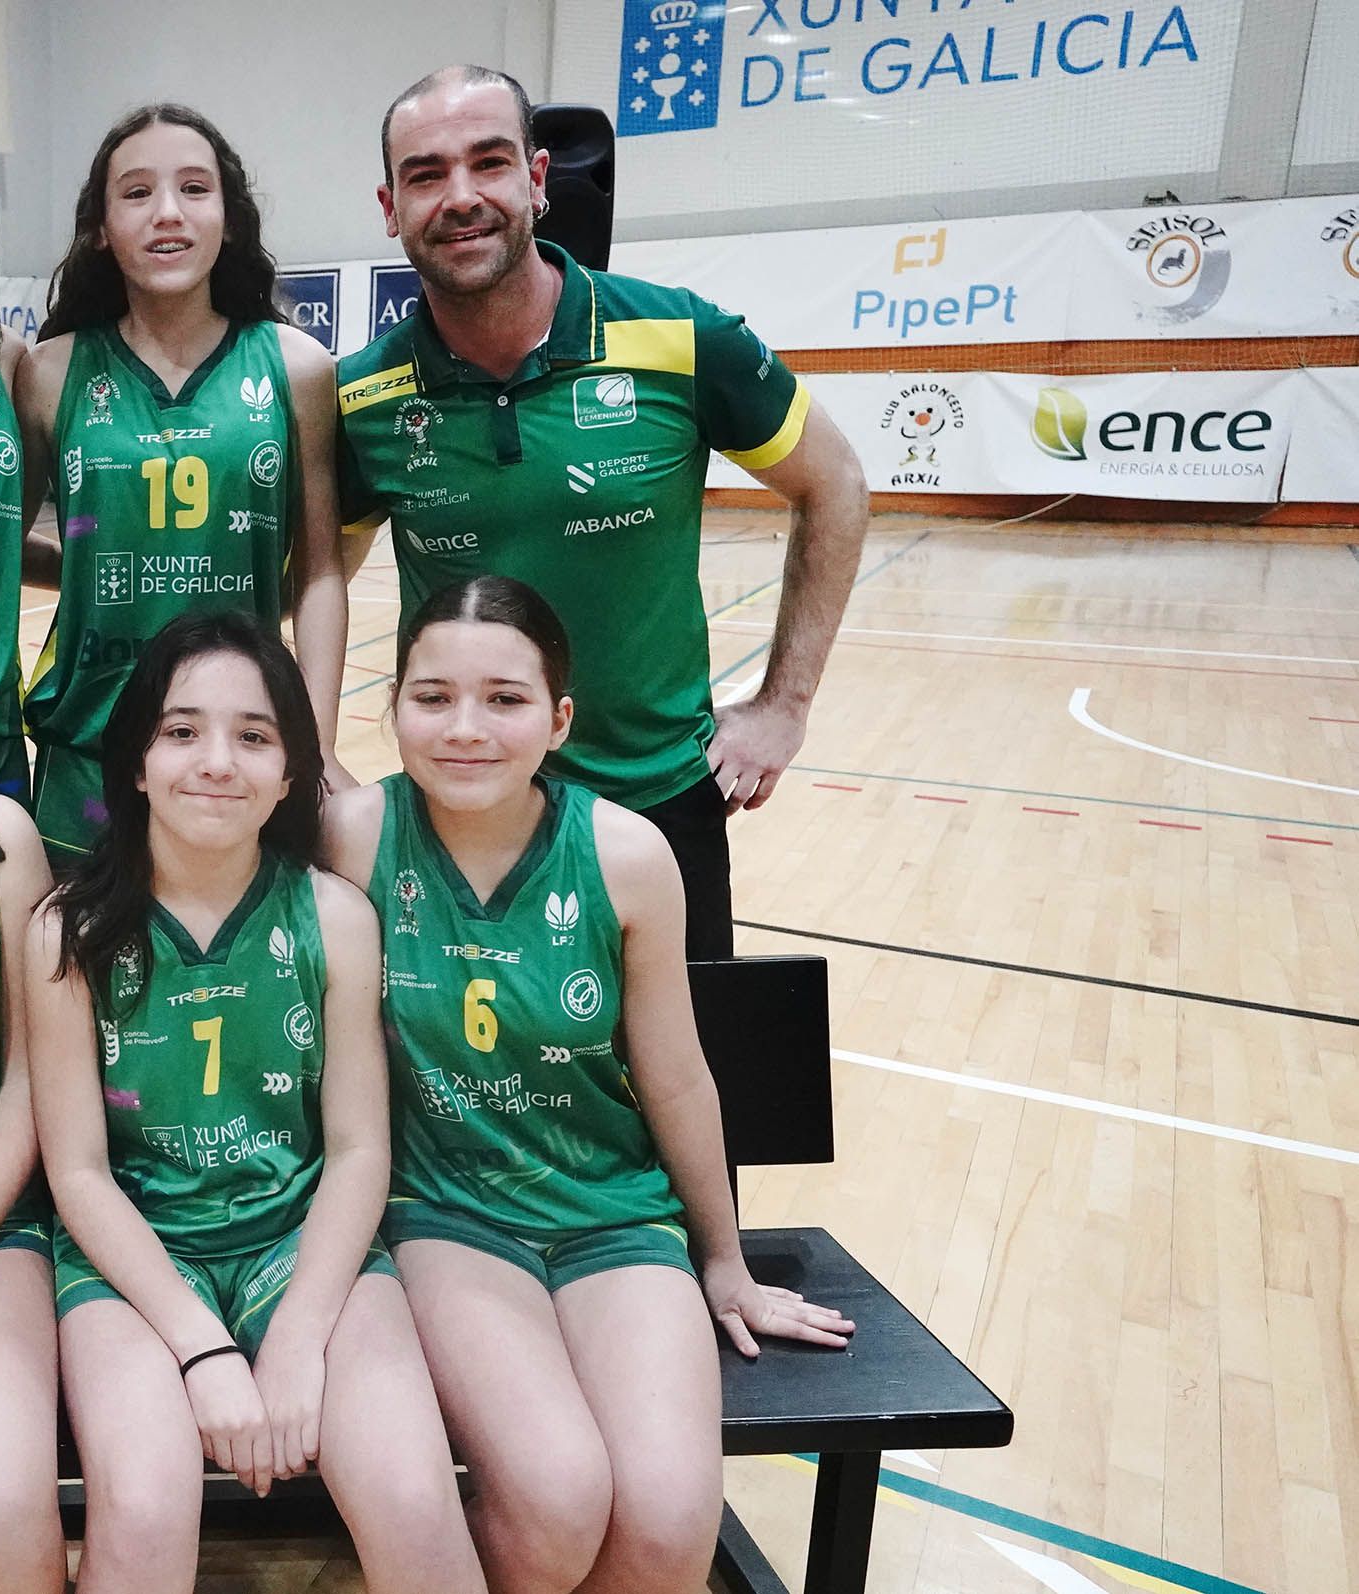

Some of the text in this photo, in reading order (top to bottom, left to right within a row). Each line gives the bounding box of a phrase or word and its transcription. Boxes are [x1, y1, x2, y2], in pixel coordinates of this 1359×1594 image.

[740, 5, 1199, 107] DE GALICIA
[1126, 214, 1229, 254] SEISOL
[249, 412, 271, 423] LF2
[1099, 410, 1273, 452] ence
[406, 457, 438, 472] ARXIL
[598, 453, 650, 469] DEPORTE
[599, 463, 647, 478] GALEGO
[1182, 463, 1265, 476] CELULOSA
[891, 472, 941, 487] ARXIL
[141, 455, 209, 529] 19
[429, 492, 470, 507] GALICIA
[425, 532, 479, 551] ence
[141, 555, 211, 573] XUNTA
[141, 573, 254, 594] DE GALICIA
[552, 935, 575, 946] LF2
[464, 979, 498, 1053] 6
[451, 1072, 522, 1096] XUNTA
[487, 1092, 572, 1114] GALICIA
[192, 1115, 248, 1146] XUNTA
[198, 1149, 220, 1168] DE
